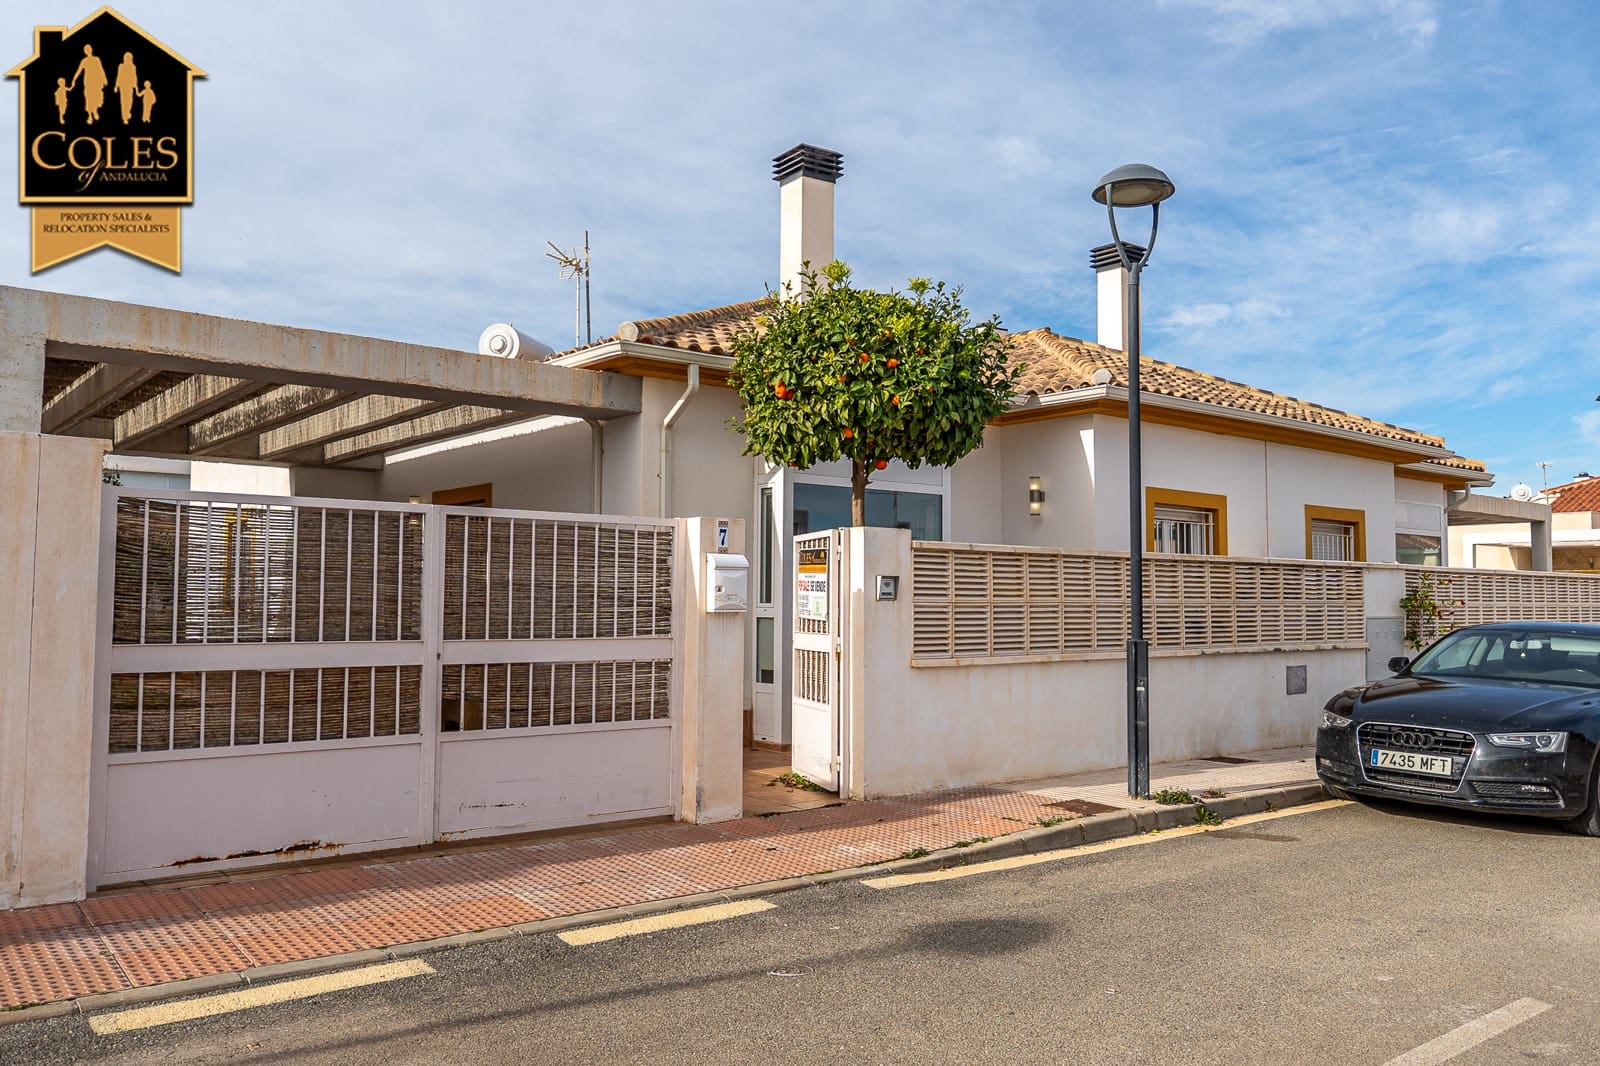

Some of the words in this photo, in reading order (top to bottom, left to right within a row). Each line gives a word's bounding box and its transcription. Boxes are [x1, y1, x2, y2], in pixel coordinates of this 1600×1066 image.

[719, 529, 727, 546] 7
[1381, 752, 1415, 768] 7435
[1420, 757, 1448, 772] MFT
